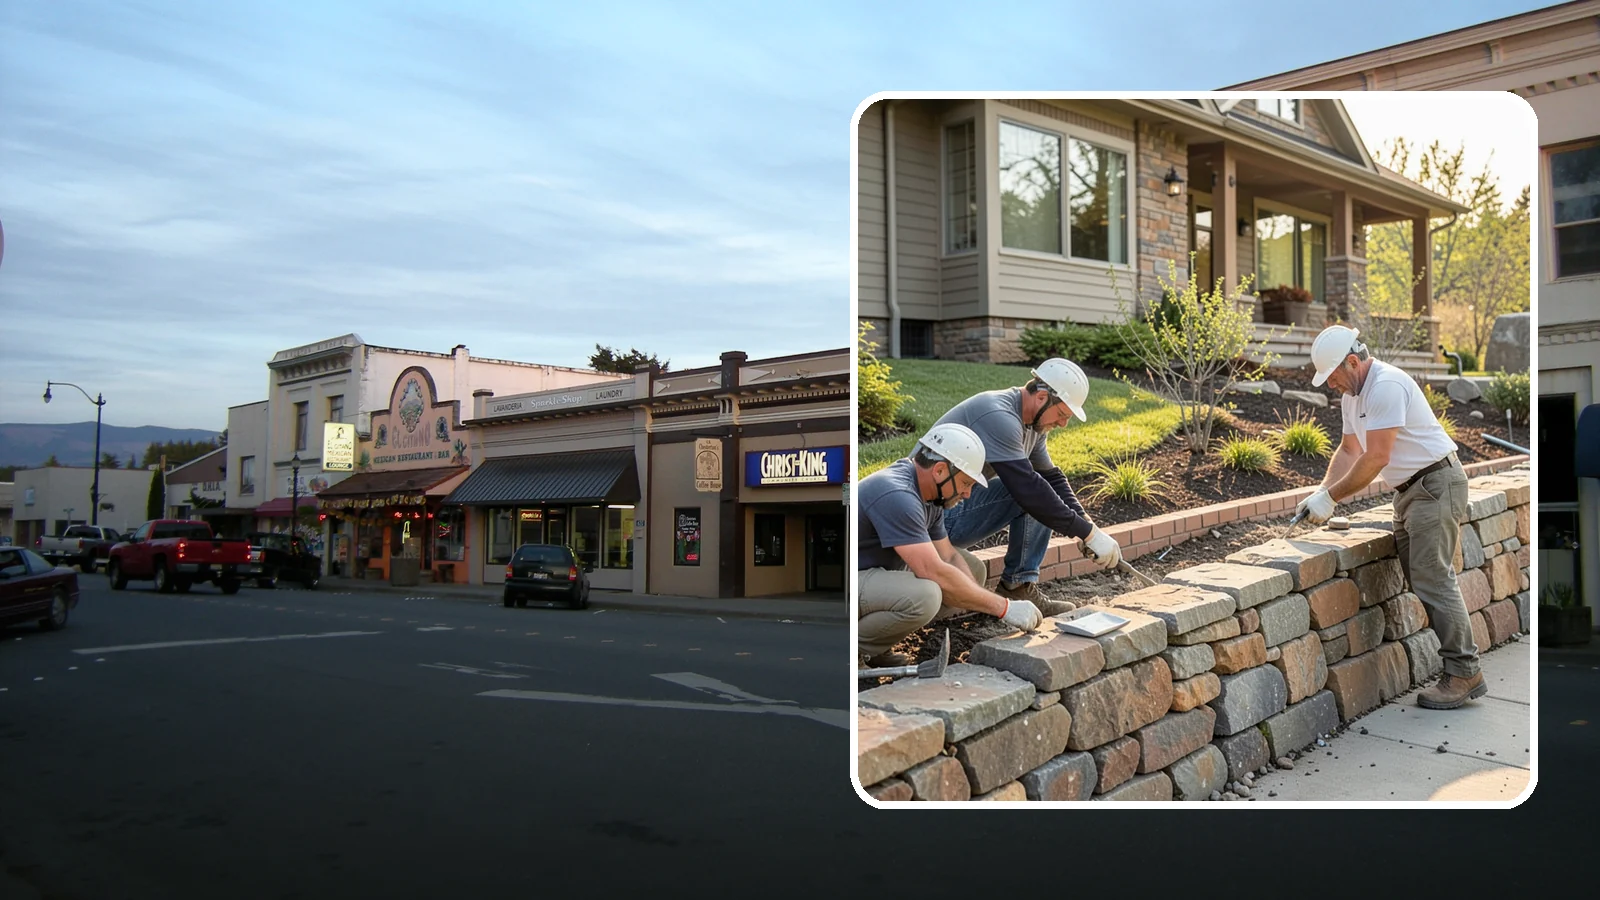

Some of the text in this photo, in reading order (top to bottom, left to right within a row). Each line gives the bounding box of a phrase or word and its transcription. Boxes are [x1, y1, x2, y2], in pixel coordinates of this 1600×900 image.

[530, 394, 582, 409] Sparkle Shop
[595, 389, 623, 400] LAUNDRY
[493, 402, 522, 412] LAVANDERIA
[373, 450, 450, 464] MEXICAN RESTAURANT BAR
[761, 450, 828, 478] CHRIST KING
